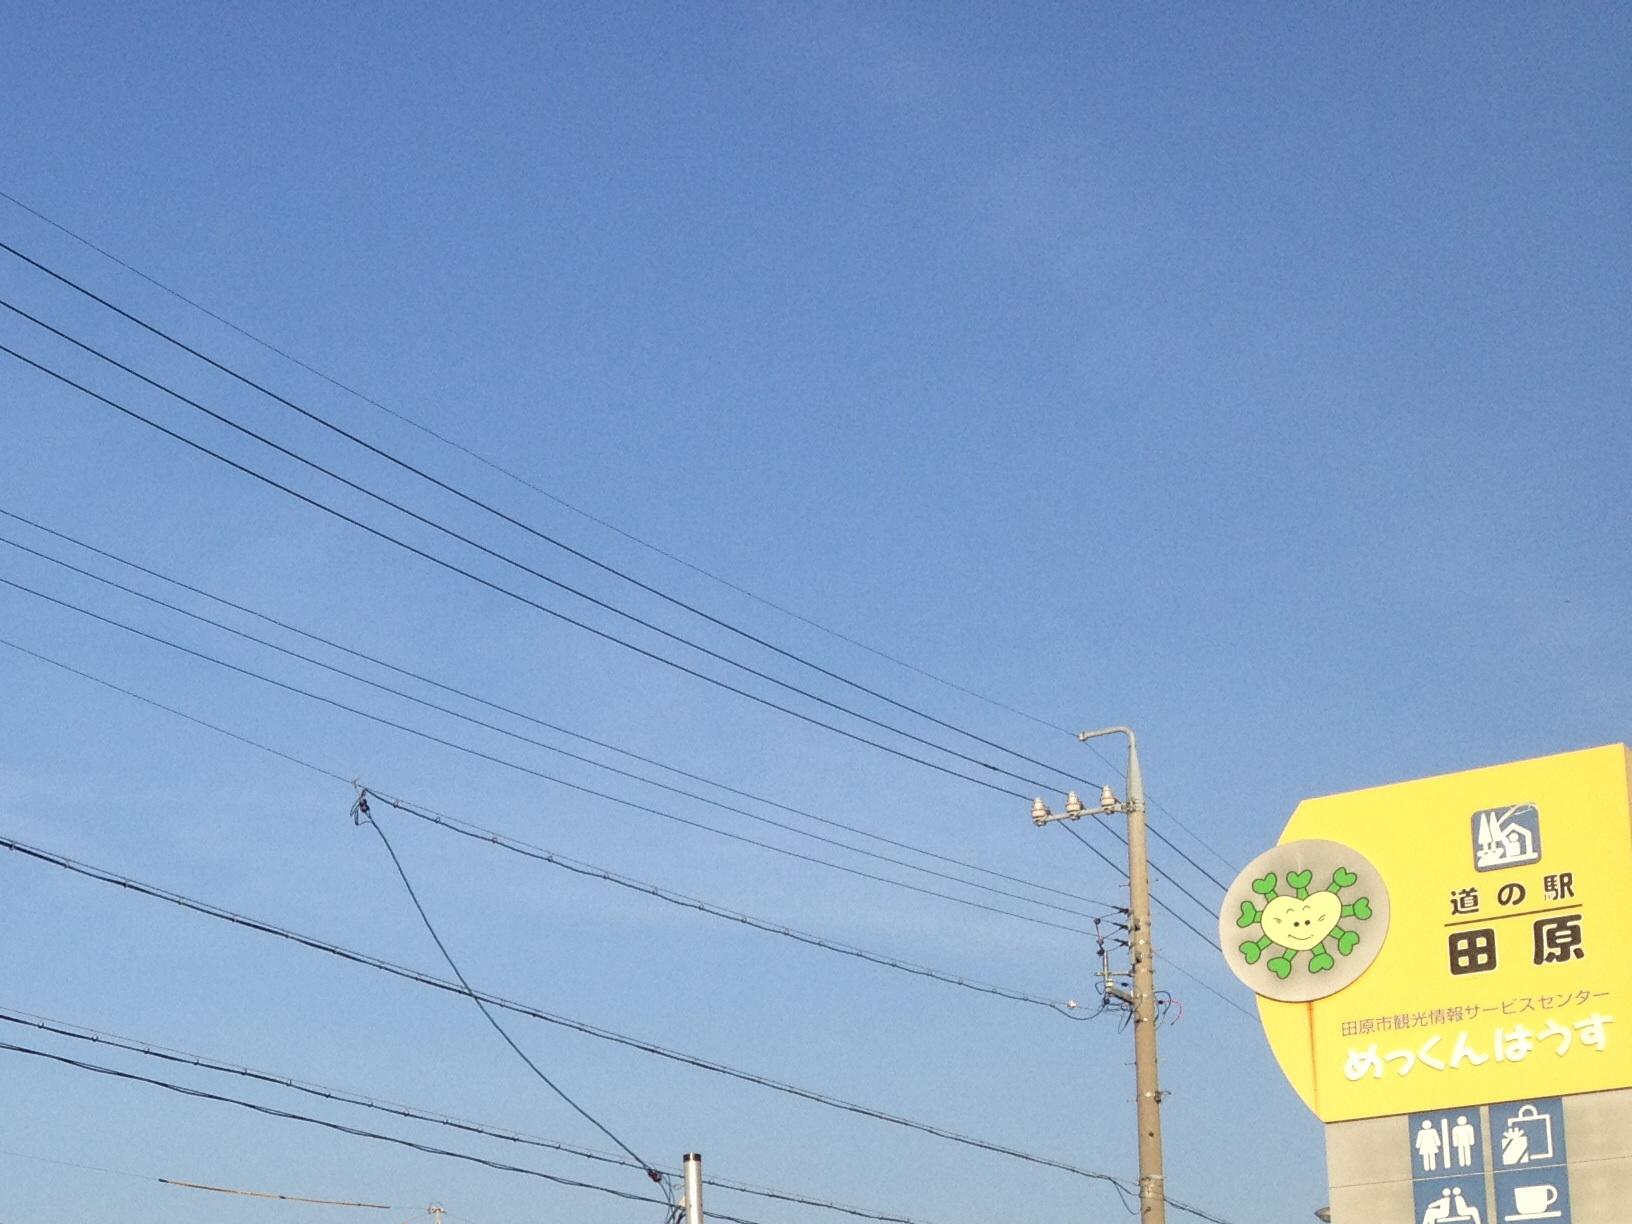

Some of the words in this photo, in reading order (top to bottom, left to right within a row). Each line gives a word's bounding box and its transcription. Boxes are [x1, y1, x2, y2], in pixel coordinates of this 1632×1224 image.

[1450, 872, 1575, 915] 道の駅
[1448, 914, 1584, 976] 田原
[1341, 988, 1611, 1037] 田原市観光情報サービスセンター
[1344, 1012, 1615, 1081] めっくんはうす
